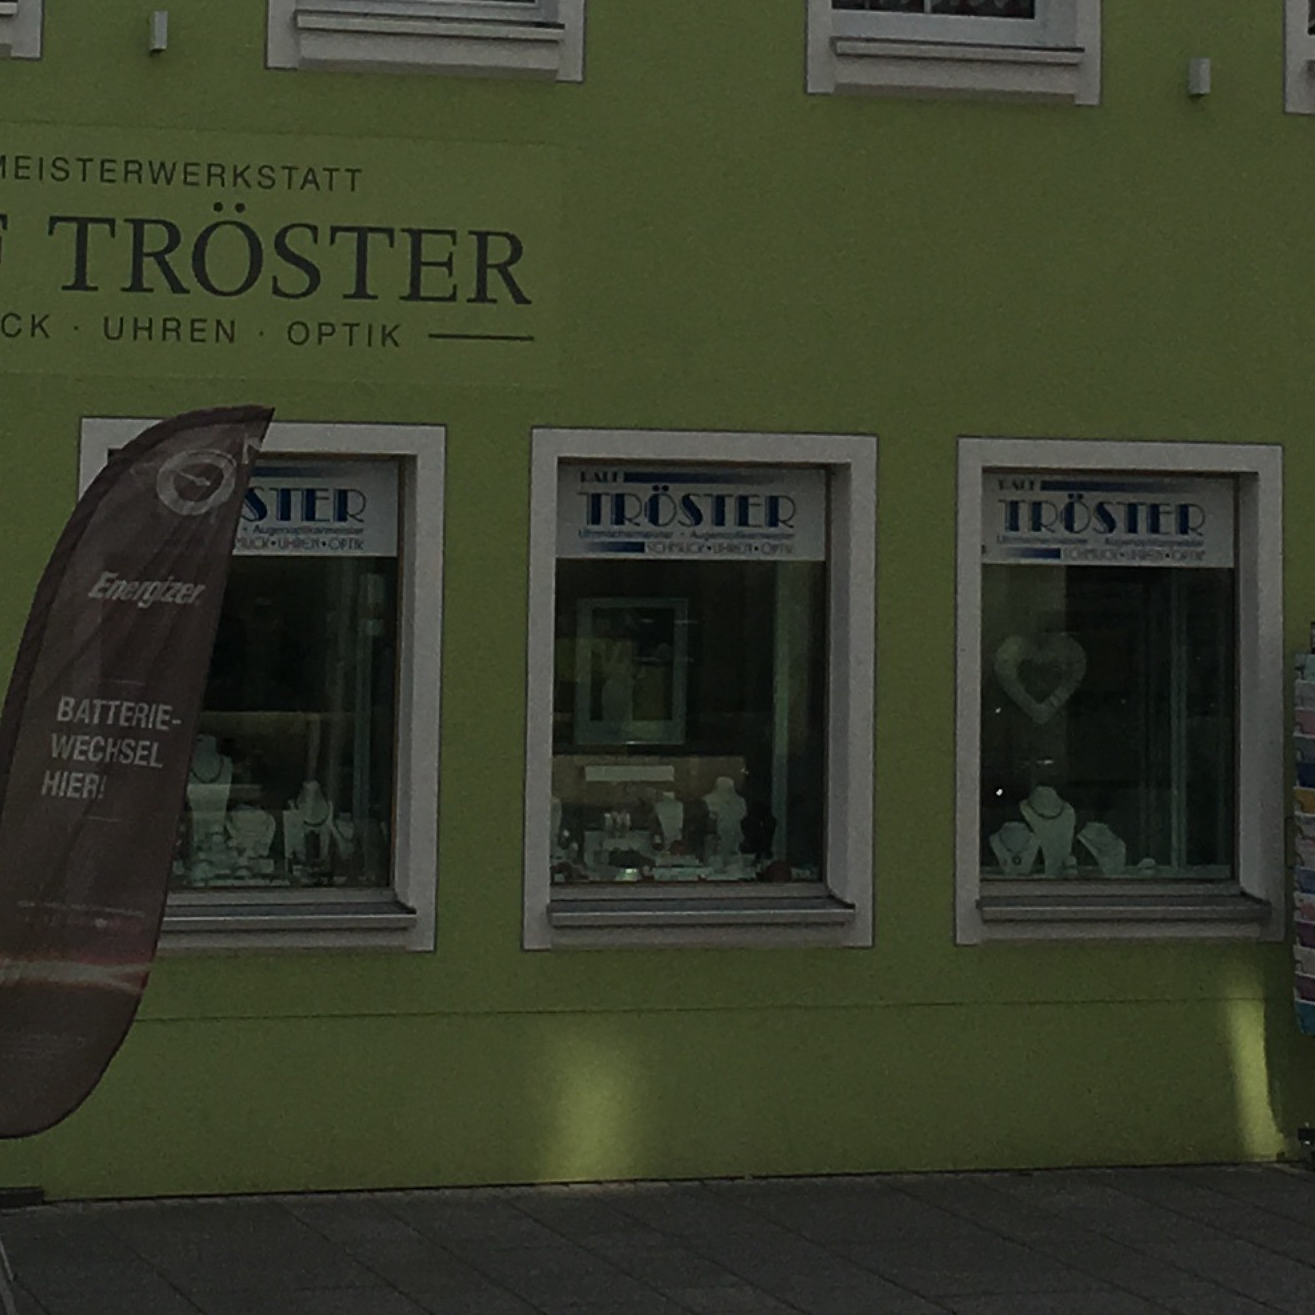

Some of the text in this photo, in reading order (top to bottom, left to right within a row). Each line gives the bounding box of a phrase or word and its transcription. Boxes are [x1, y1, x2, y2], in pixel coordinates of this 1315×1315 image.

[48, 200, 532, 306] TRÖSTER
[103, 316, 237, 345] UHREN
[287, 321, 402, 347] OPTIK
[242, 486, 367, 523] STER
[577, 485, 797, 529] TRÖSTER
[998, 493, 1206, 536] TRÖSTER
[87, 571, 206, 609] Energizer
[56, 696, 183, 729] BATTERIE-
[51, 734, 164, 769] WECHSEL
[41, 771, 106, 800] HIER!
